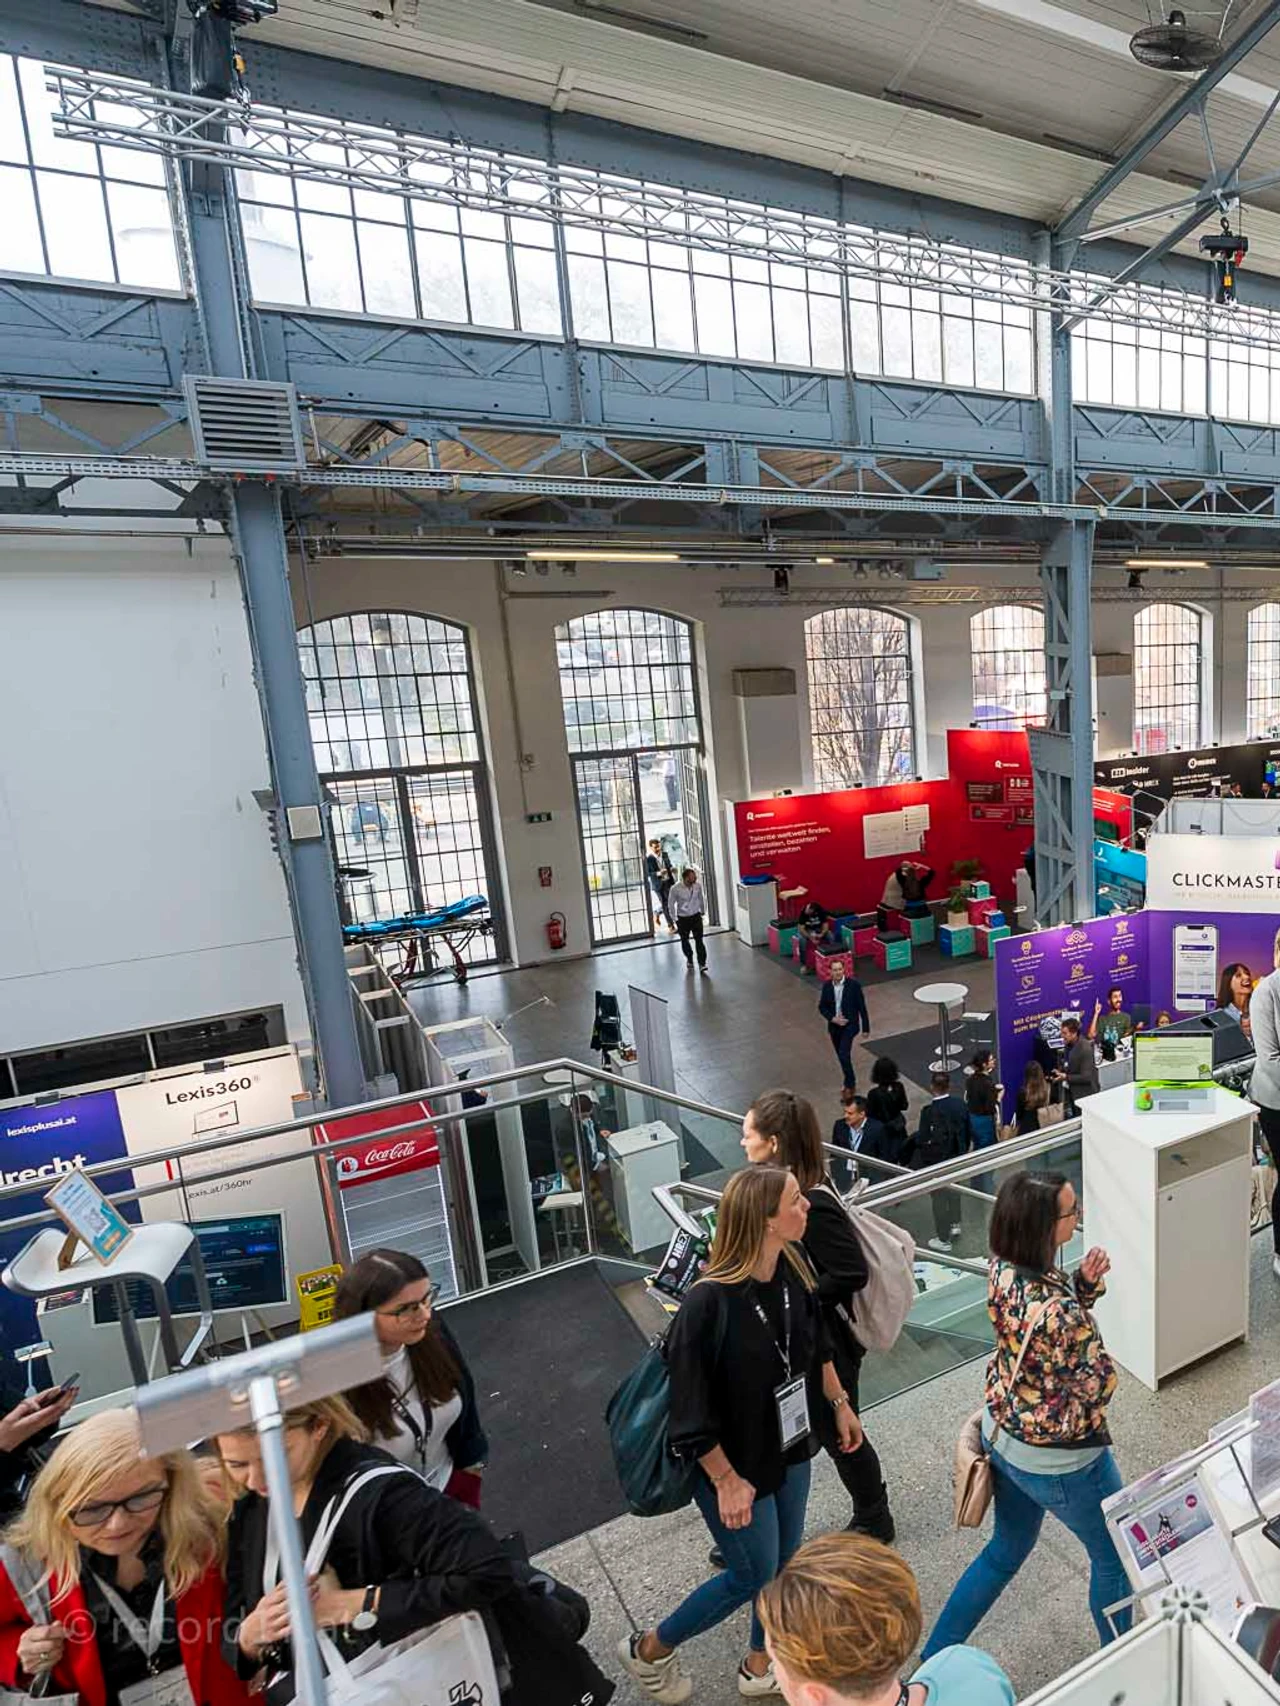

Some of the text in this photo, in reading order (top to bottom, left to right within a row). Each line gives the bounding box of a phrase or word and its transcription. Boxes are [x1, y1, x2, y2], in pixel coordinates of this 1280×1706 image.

[750, 834, 776, 843] Talente
[777, 829, 807, 839] weltweit
[807, 826, 831, 835] finden,
[750, 835, 818, 850] einstellen, bezahlen
[750, 845, 802, 858] und verwalten
[7, 1115, 78, 1137] lexisplusai.at
[0, 1153, 88, 1187] recht
[187, 1177, 254, 1200] exis.at/360hr
